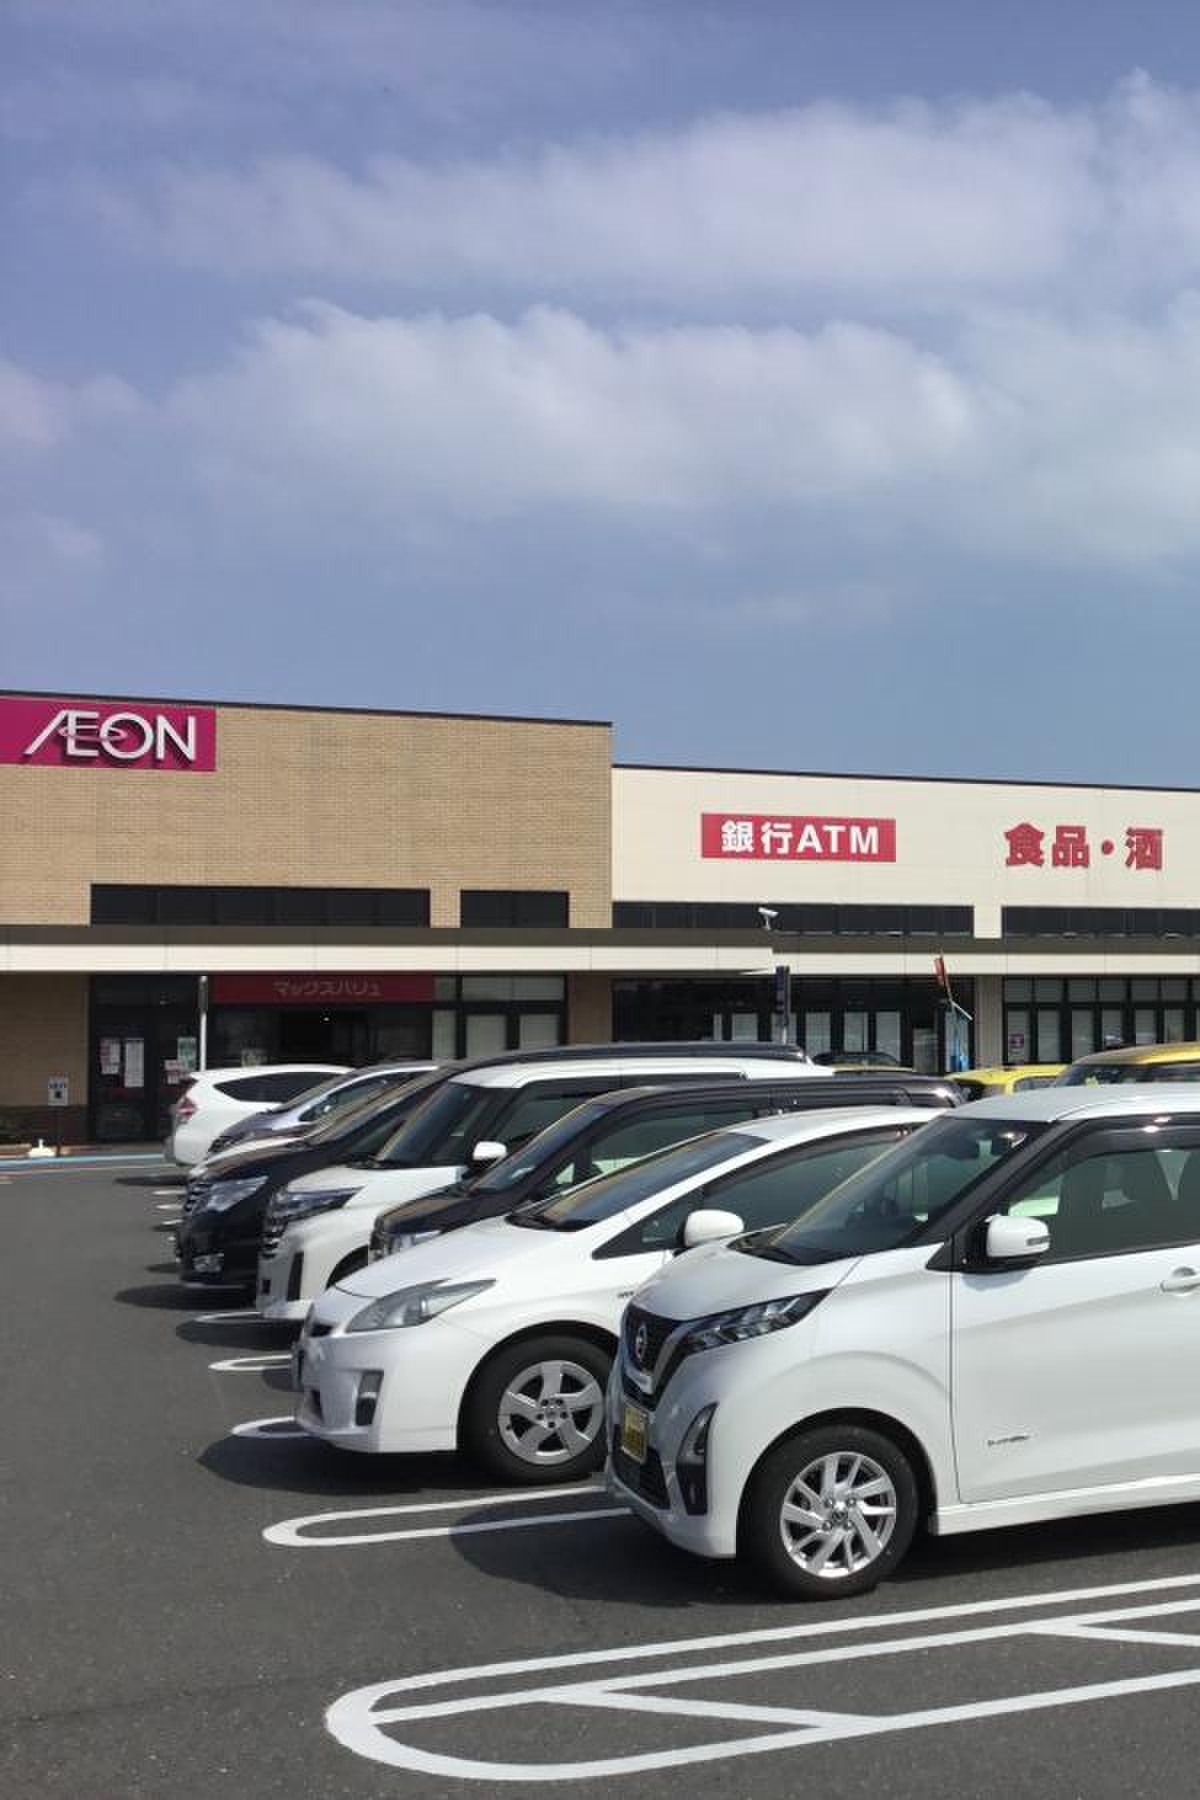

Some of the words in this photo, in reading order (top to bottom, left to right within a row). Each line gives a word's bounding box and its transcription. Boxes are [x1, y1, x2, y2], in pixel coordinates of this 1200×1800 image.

[720, 819, 881, 856] 銀行ATM
[1004, 822, 1164, 871] 食品・酒
